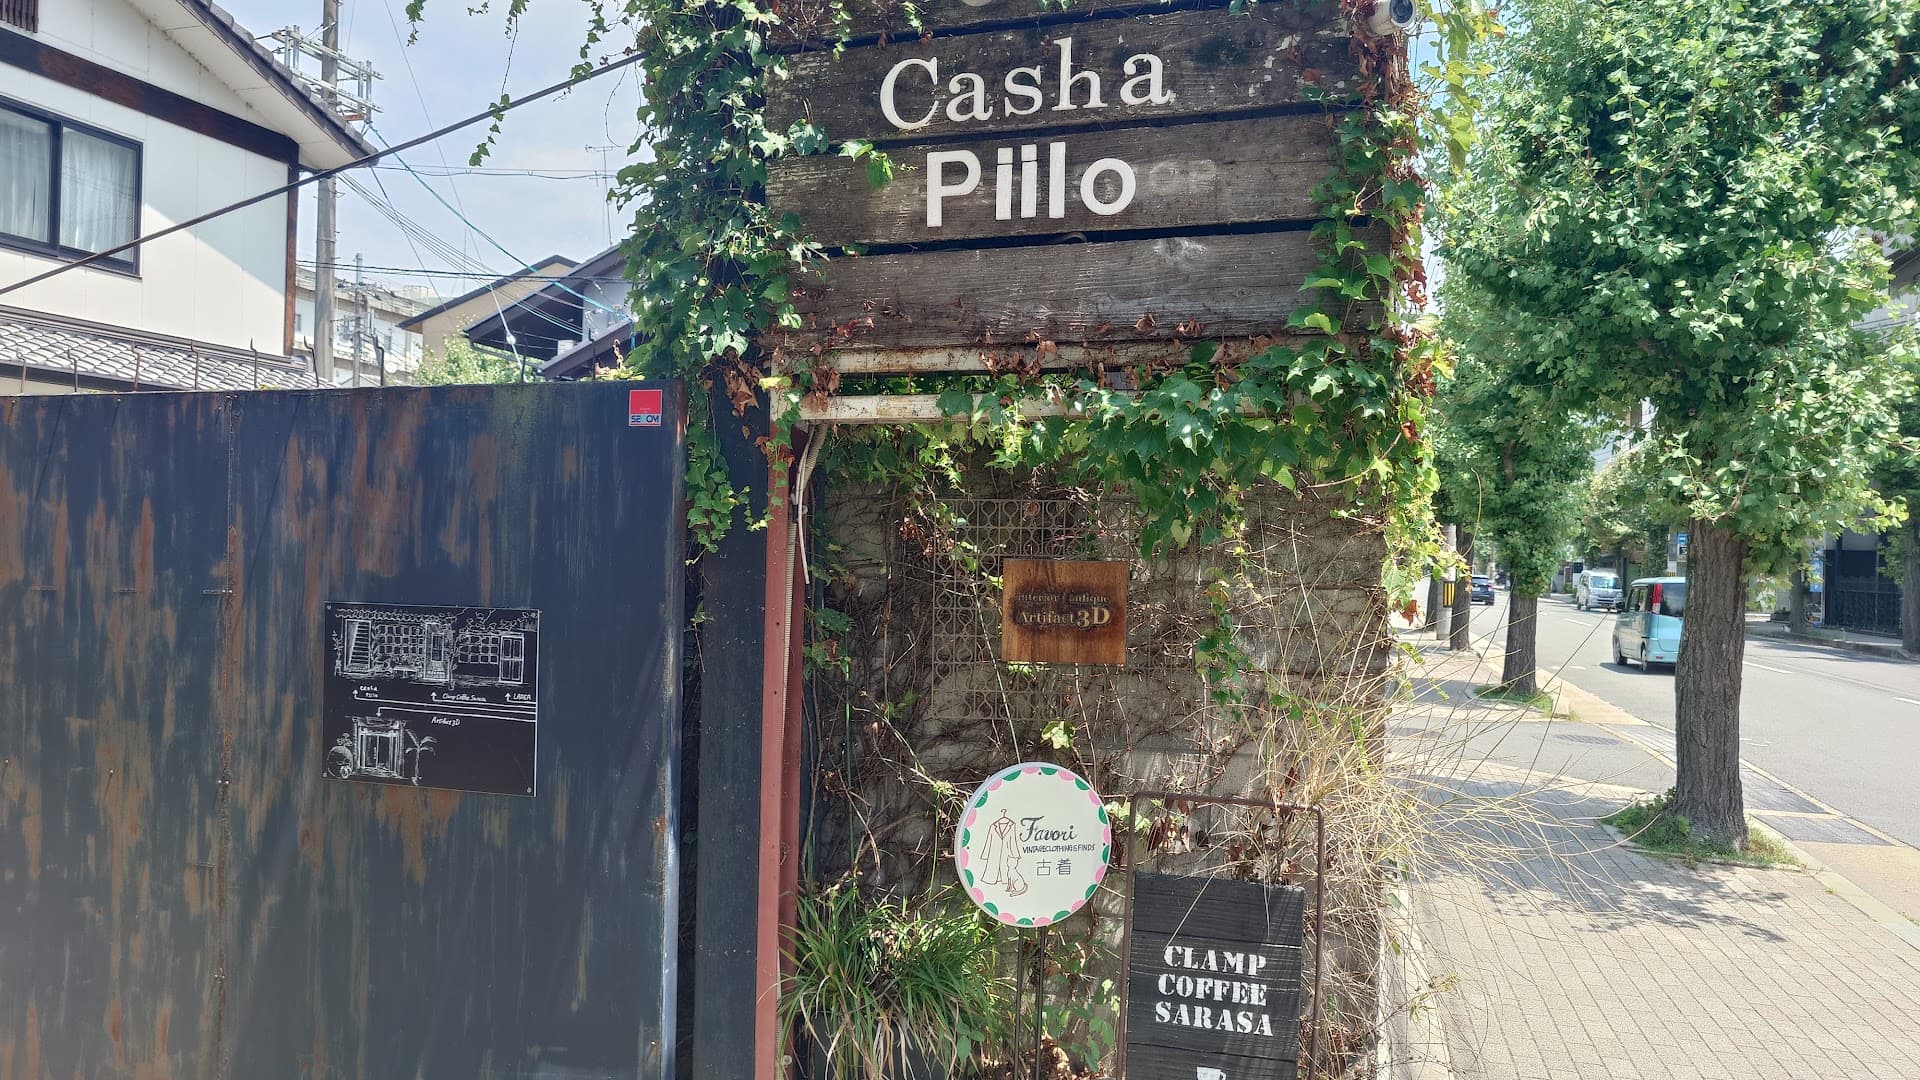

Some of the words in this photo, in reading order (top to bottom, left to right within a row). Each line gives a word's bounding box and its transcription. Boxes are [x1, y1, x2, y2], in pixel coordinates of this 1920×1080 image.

[880, 36, 1176, 130] Casha
[926, 141, 1137, 228] Piilo
[1019, 816, 1078, 843] Favori
[1036, 858, 1072, 876] 古着
[1163, 945, 1267, 976] CLAMP
[1157, 973, 1267, 1007] COFFEE
[1155, 1000, 1273, 1037] SARASA
